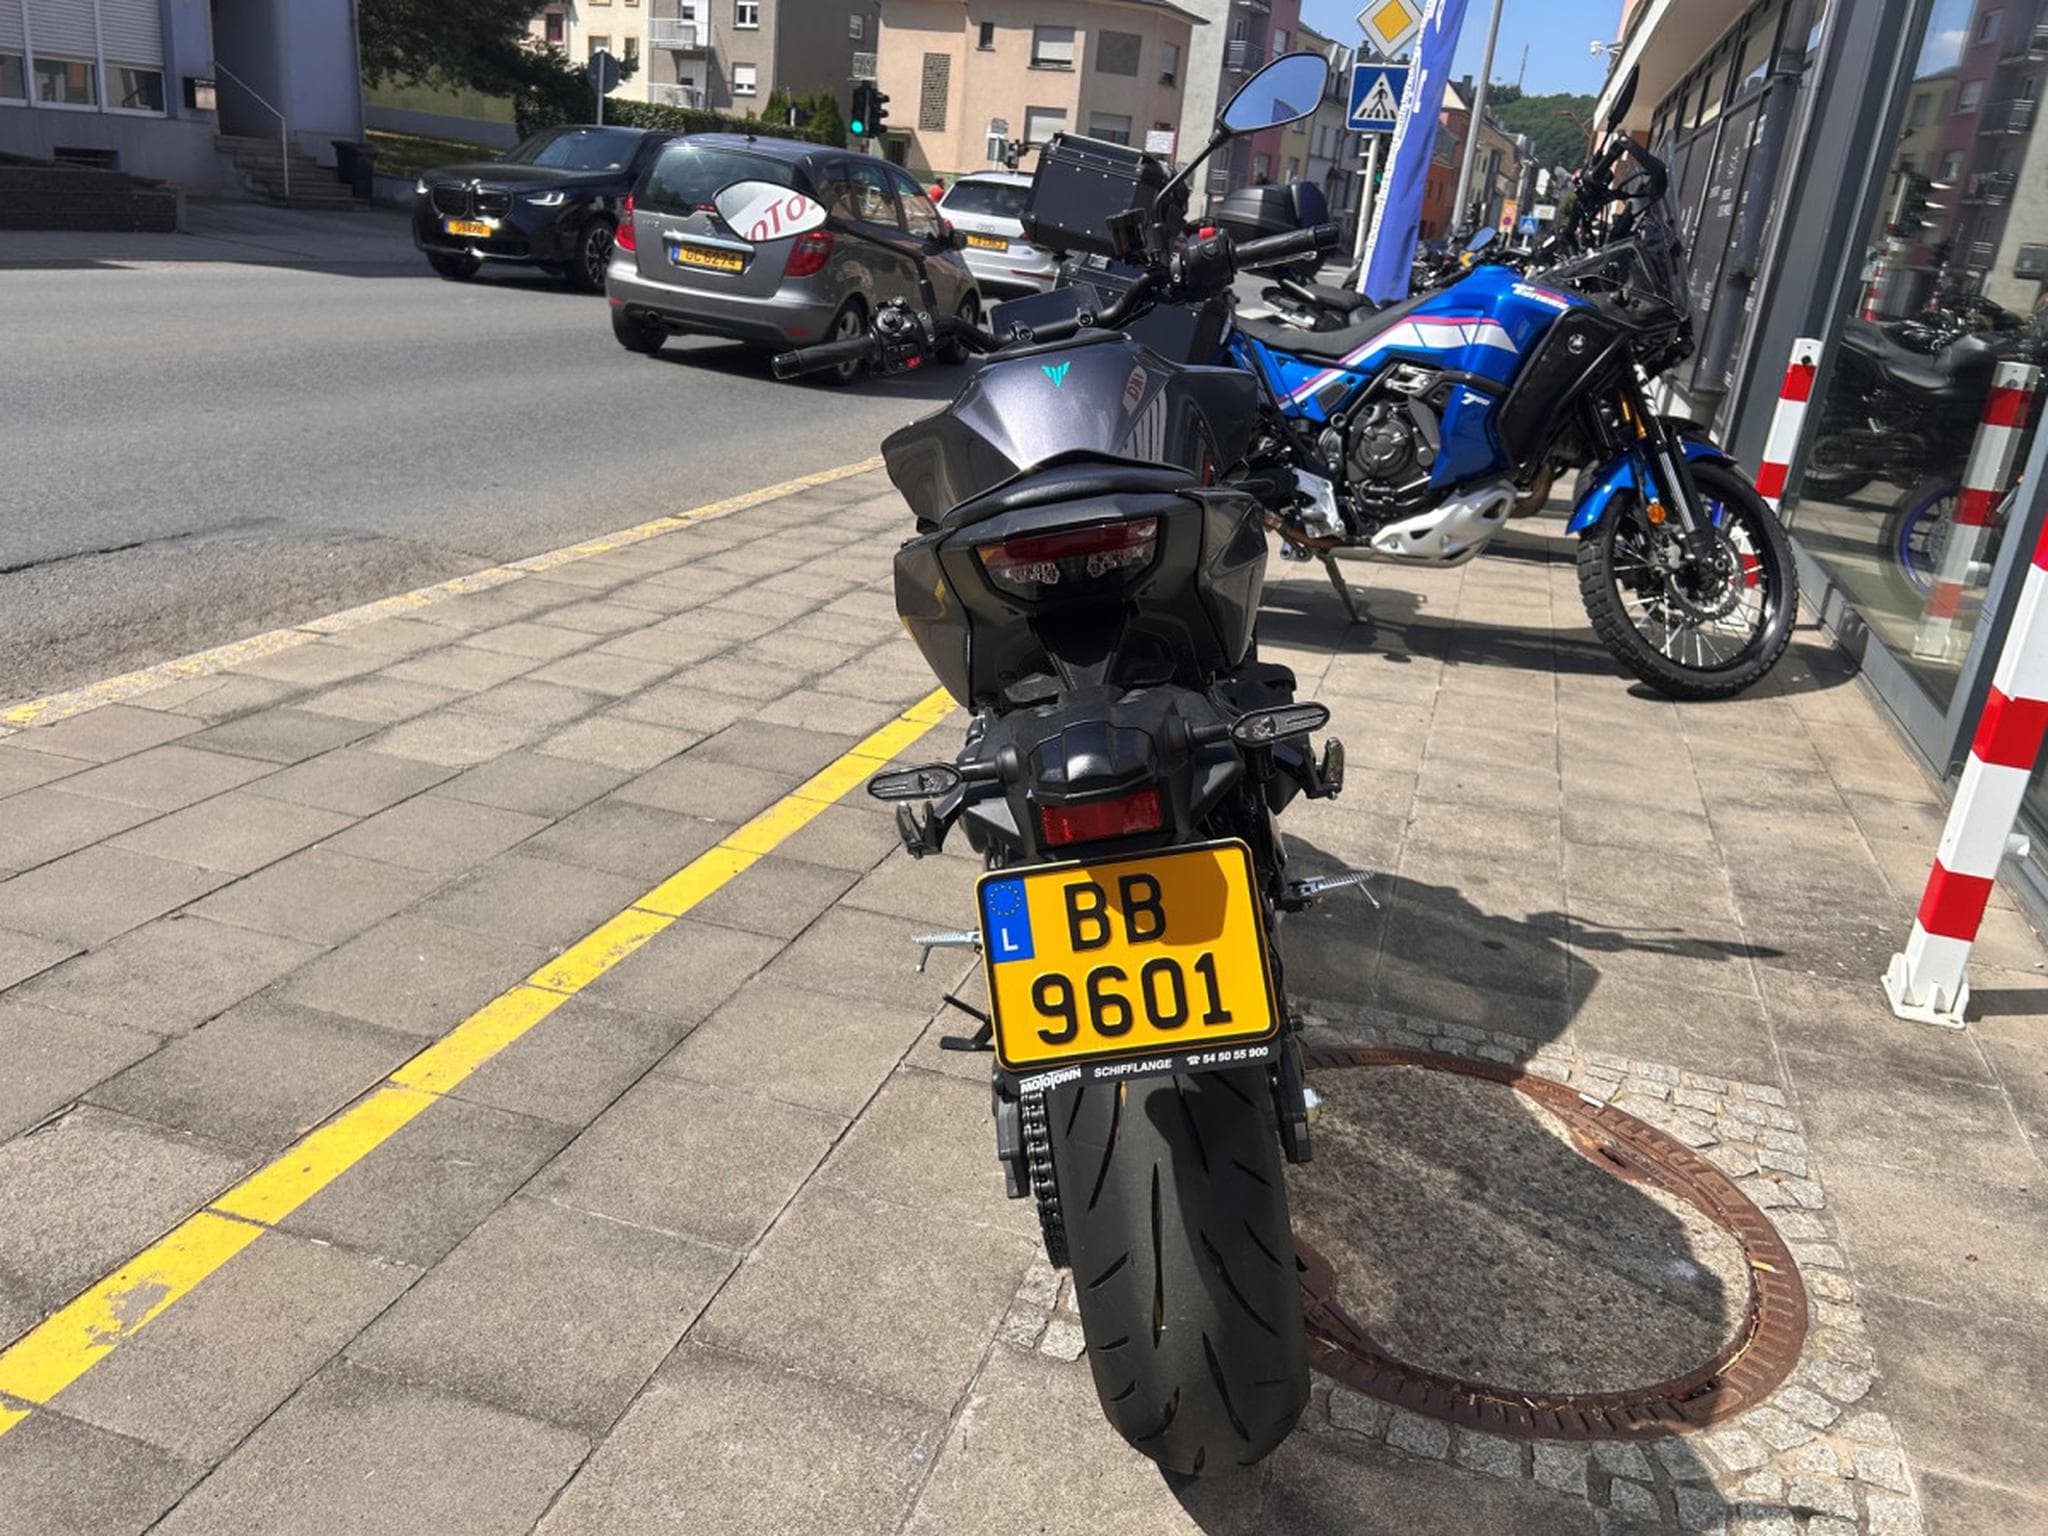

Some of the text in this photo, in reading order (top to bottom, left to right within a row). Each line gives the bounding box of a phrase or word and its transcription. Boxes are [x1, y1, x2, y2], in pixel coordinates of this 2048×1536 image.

[1063, 873, 1166, 952] BB
[1001, 928, 1019, 952] L
[1031, 952, 1234, 1046] 9601
[1094, 1058, 1172, 1078] SCHIFFLANGE
